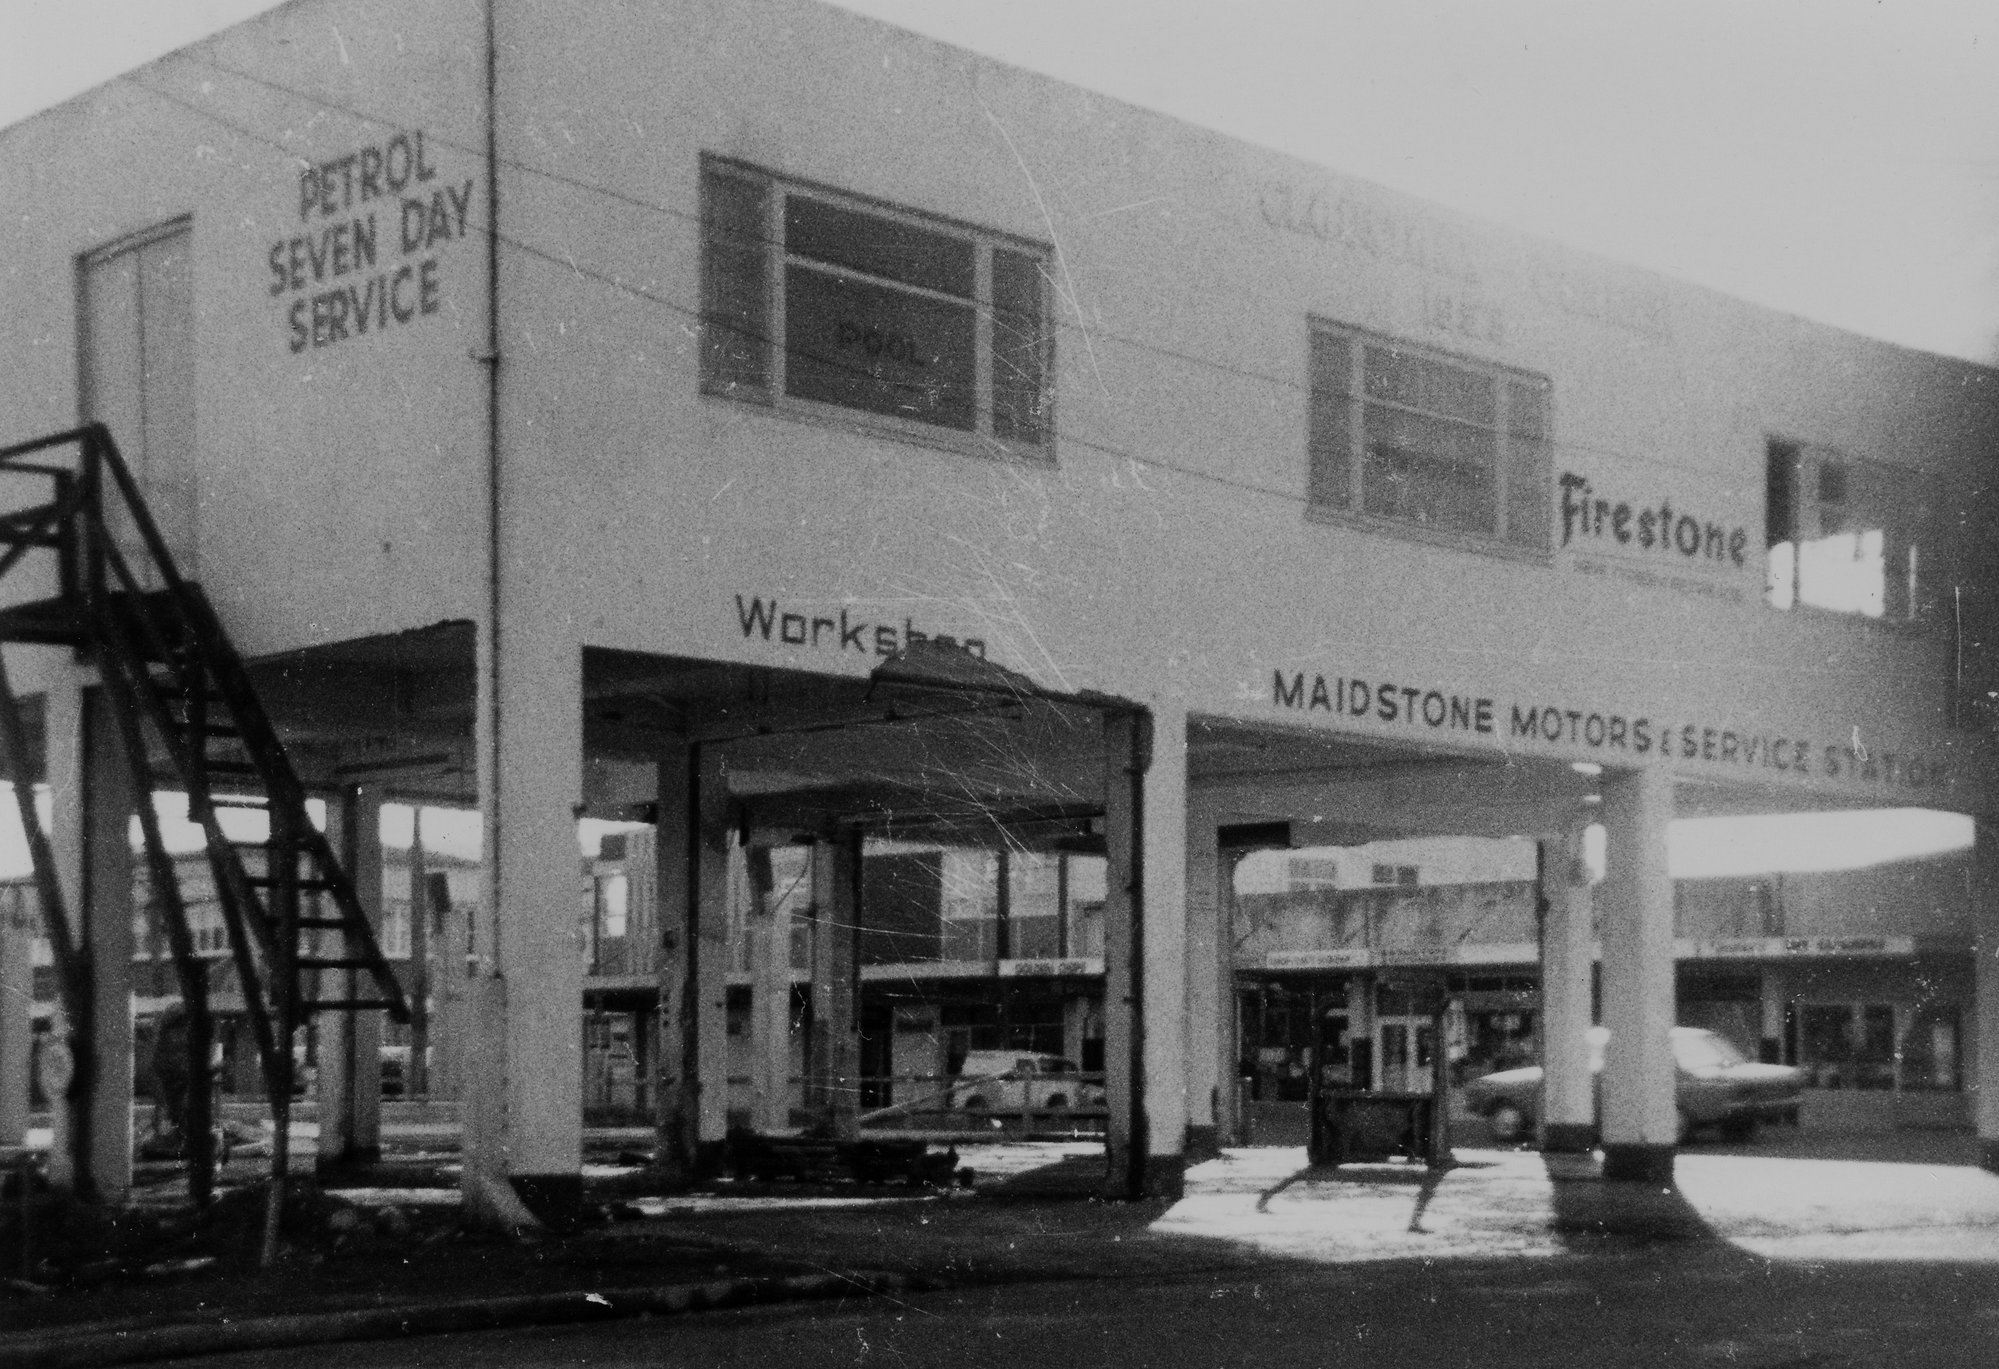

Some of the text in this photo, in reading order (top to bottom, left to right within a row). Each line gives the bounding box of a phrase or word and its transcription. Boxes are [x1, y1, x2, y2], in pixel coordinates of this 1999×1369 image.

[301, 129, 437, 222] PETROL
[269, 179, 473, 296] SEVEN DAY
[289, 259, 439, 353] SERVICE
[1558, 470, 1749, 569] Firestone
[1272, 668, 1495, 734] MAIDSTONE
[1510, 704, 1653, 753] MOTORS
[1680, 723, 1809, 774] SERVICE
